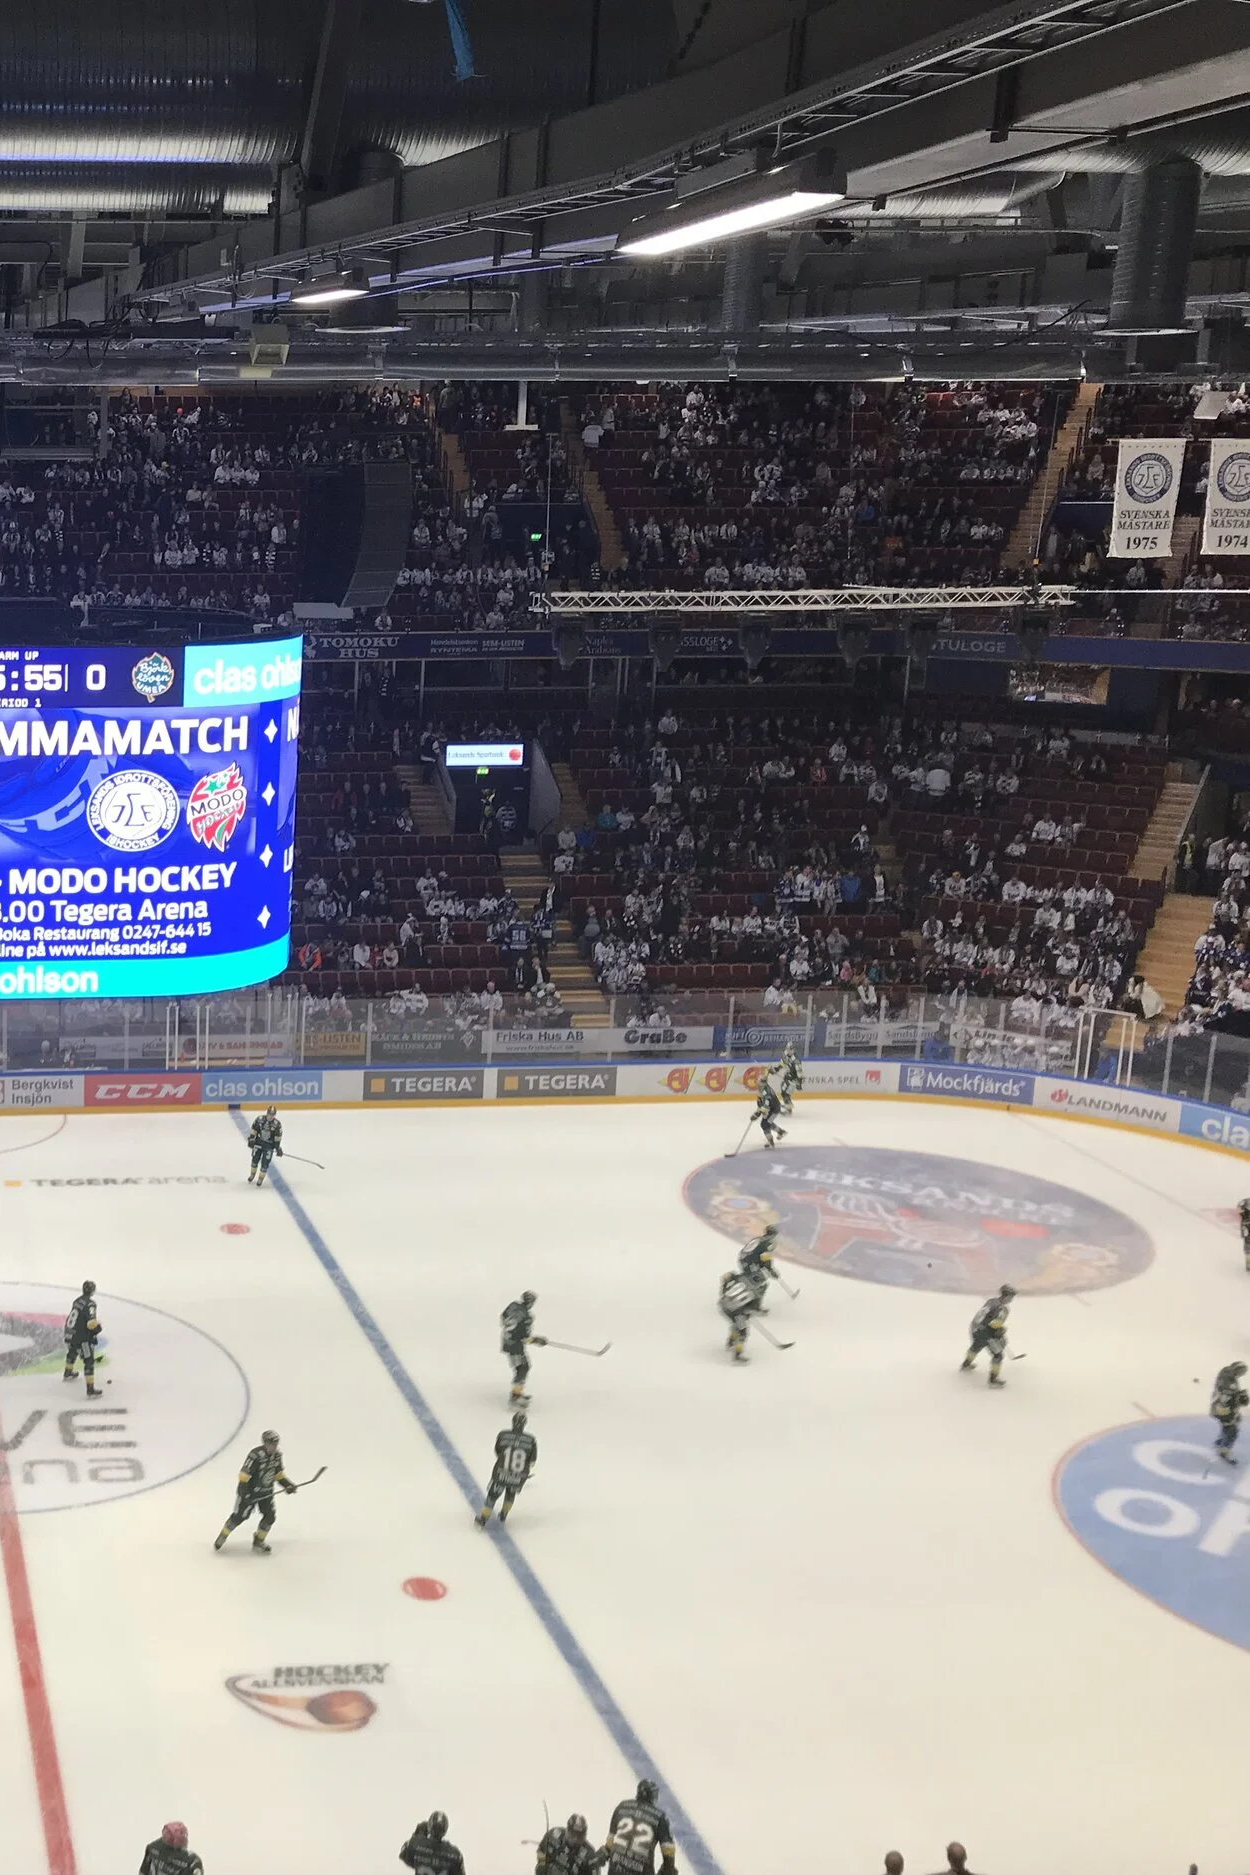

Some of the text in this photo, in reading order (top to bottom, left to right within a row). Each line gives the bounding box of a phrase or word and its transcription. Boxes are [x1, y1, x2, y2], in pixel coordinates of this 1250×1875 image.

[1119, 509, 1171, 519] SVENSKA
[1126, 536, 1158, 550] 1975
[1216, 534, 1248, 548] 1974
[319, 636, 400, 648] TOMOKU
[24, 651, 39, 660] UP
[338, 648, 380, 659] HUS
[86, 664, 107, 692] 0
[194, 658, 256, 695] clas
[34, 698, 42, 708] 1
[191, 788, 244, 817] MODO
[9, 867, 108, 894] MODO
[114, 861, 238, 893] HOCKEY
[50, 899, 132, 925] Tegera
[137, 898, 208, 921] Arena
[33, 925, 120, 942] Restaurang
[122, 923, 195, 940] 0247-644
[198, 922, 212, 936] 15
[27, 941, 46, 959] på
[49, 940, 187, 956] www.leksandsif.se
[496, 1030, 584, 1042] Friska Hus AB
[12, 1078, 73, 1093] Bergkvist
[205, 1072, 319, 1098] clas ohlson
[391, 1076, 472, 1093] TEGERA
[525, 1074, 606, 1090] TEGERA
[838, 1076, 861, 1085] SPEL
[926, 1072, 1020, 1097] Mockfjärds
[12, 1093, 52, 1106] Insjön
[95, 1083, 192, 1100] CCM
[1067, 1094, 1168, 1122] LANDMANN
[766, 1163, 1077, 1222] LEKSANDS
[502, 1446, 527, 1473] 18
[273, 1662, 391, 1677] HOCKEY
[613, 1817, 655, 1857] 22
